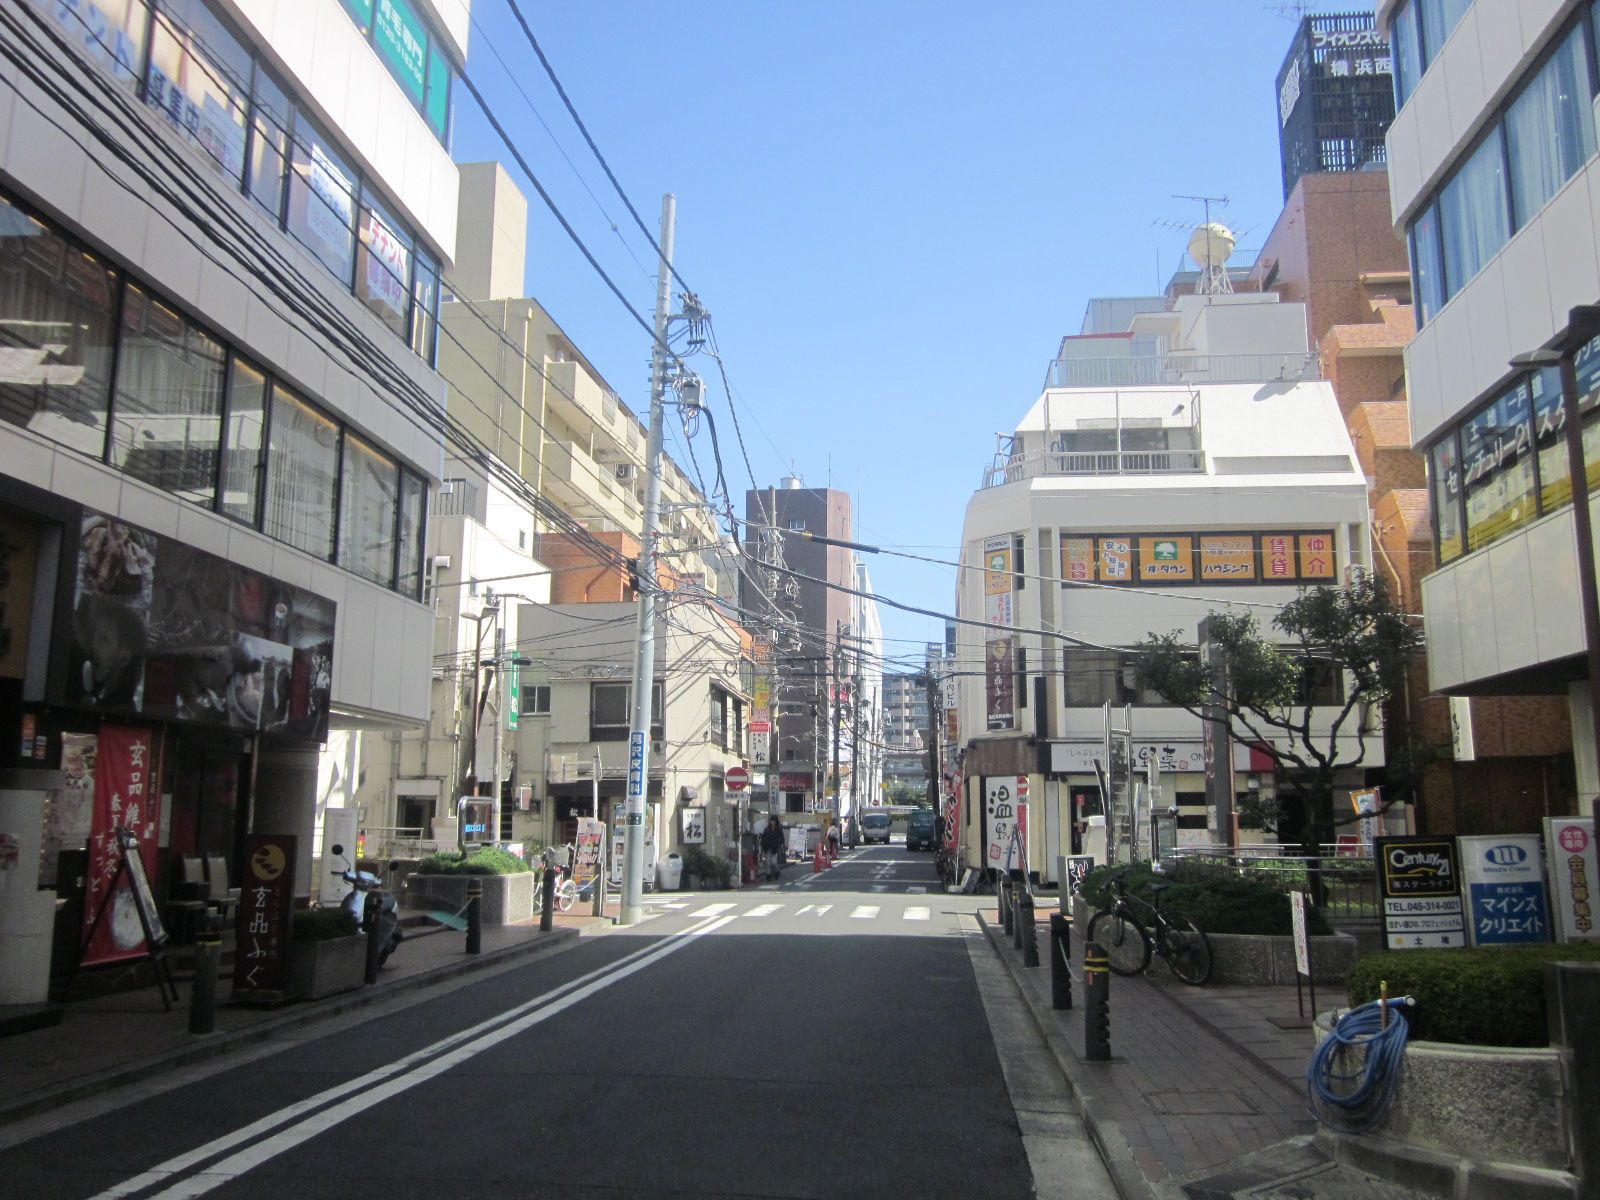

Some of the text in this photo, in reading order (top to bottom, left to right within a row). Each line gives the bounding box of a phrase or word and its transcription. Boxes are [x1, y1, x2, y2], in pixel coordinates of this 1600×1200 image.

[1313, 30, 1388, 47] ライオンズマ
[1269, 537, 1288, 576] 賃貸
[1306, 537, 1326, 575] 仲介
[1203, 563, 1253, 574] ハウジング
[686, 822, 702, 840] 松
[1390, 849, 1450, 876] Century 21
[1480, 895, 1539, 914] マインズ
[1480, 916, 1544, 935] クリエイト
[246, 886, 272, 987] 玄品ふぐ
